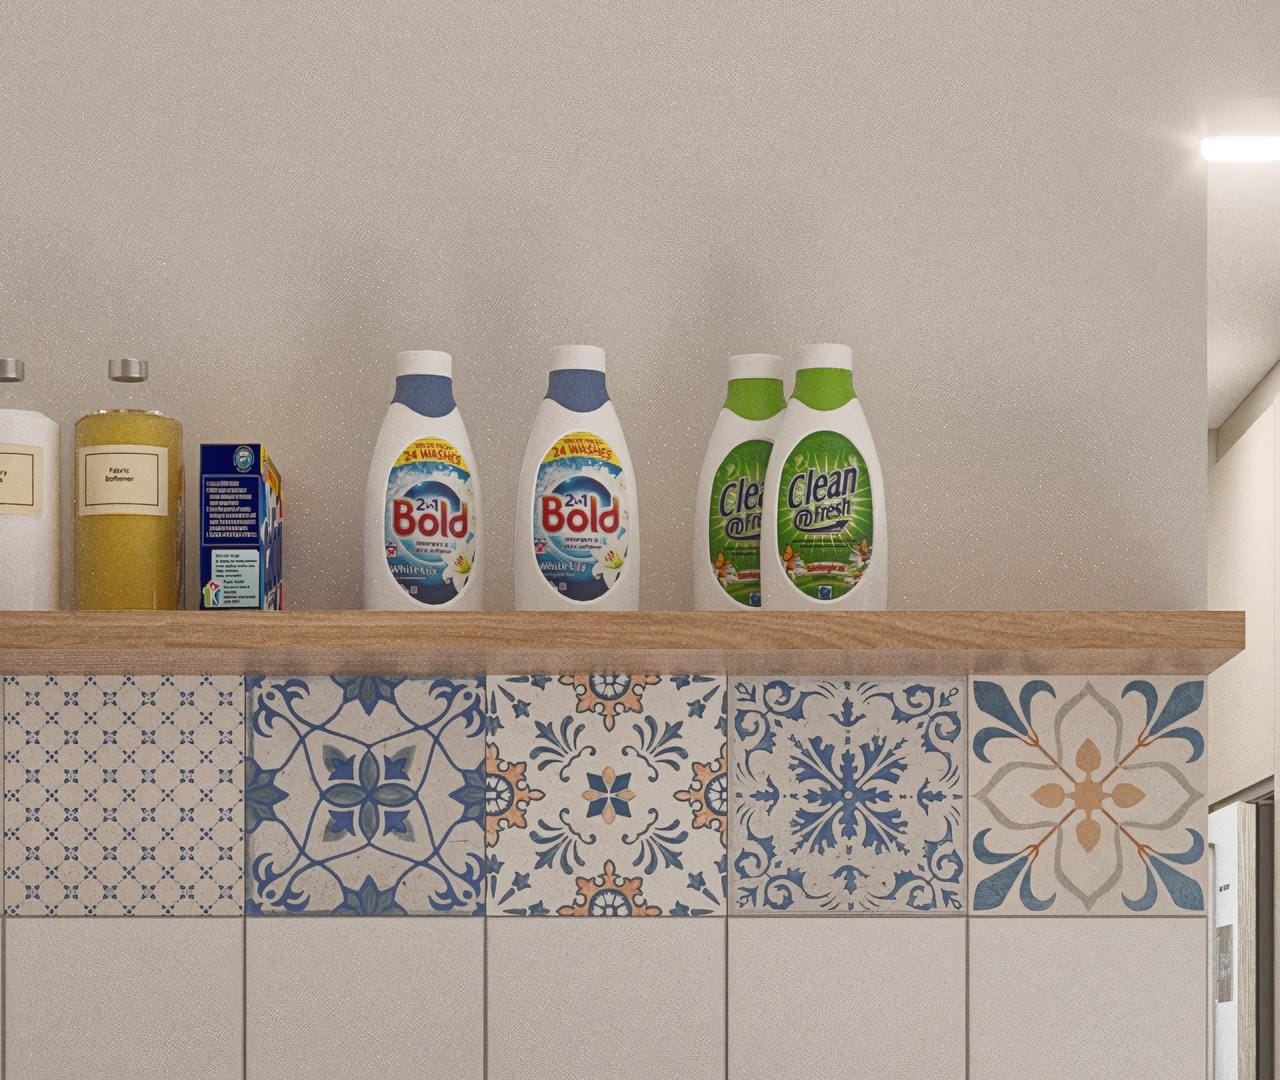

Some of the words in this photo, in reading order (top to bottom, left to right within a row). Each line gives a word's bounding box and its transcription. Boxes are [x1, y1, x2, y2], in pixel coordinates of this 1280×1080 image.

[788, 467, 857, 508] Clean
[393, 499, 468, 539] Bold
[542, 495, 619, 534] Bold
